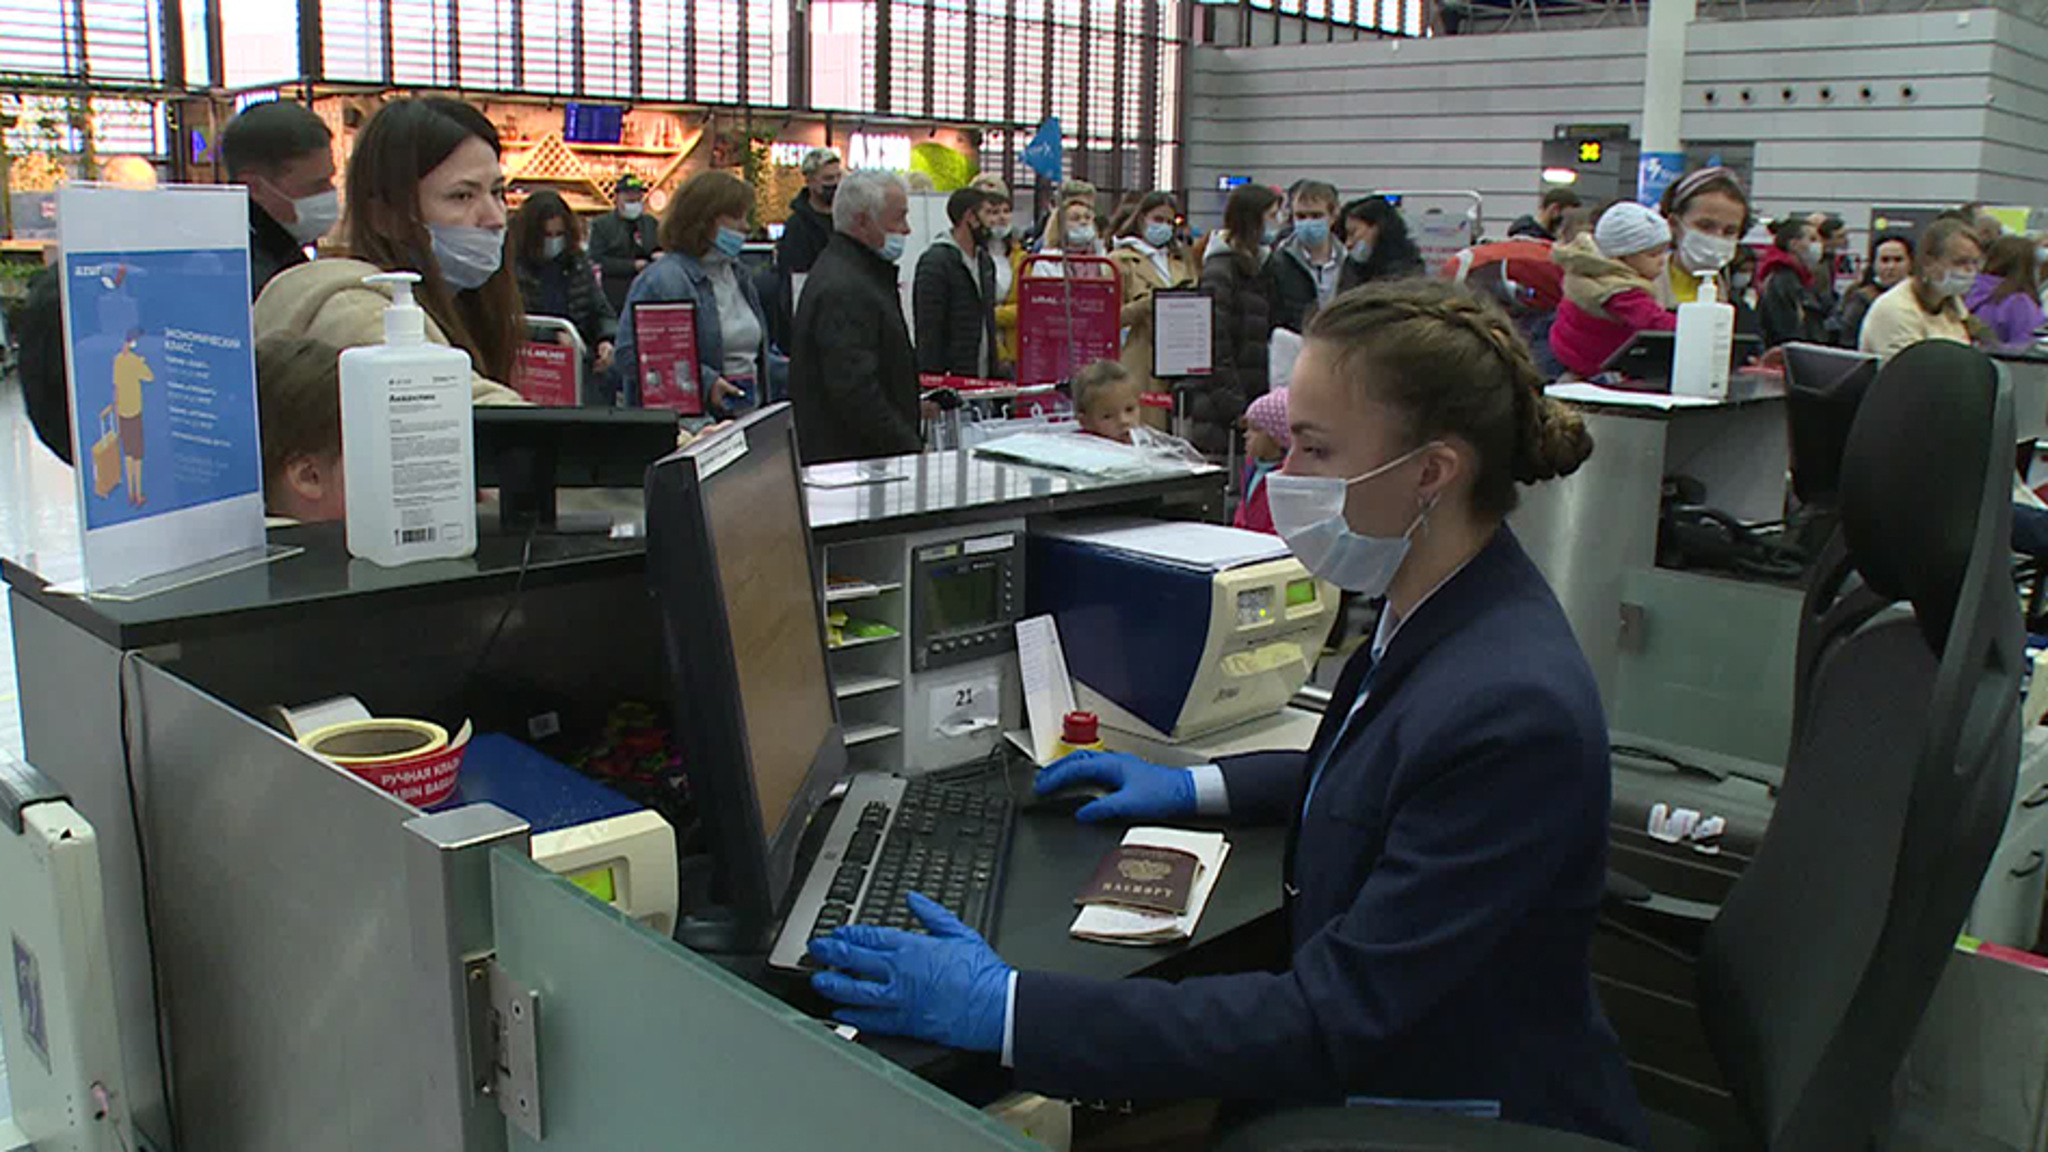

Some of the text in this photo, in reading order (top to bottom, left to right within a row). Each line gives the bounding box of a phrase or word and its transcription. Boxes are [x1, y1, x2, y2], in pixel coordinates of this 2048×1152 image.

[956, 688, 973, 707] 21
[381, 765, 432, 787] РУЧНАЯ
[392, 783, 423, 800] ABIN
[1102, 881, 1175, 899] ПАСПОРТ
